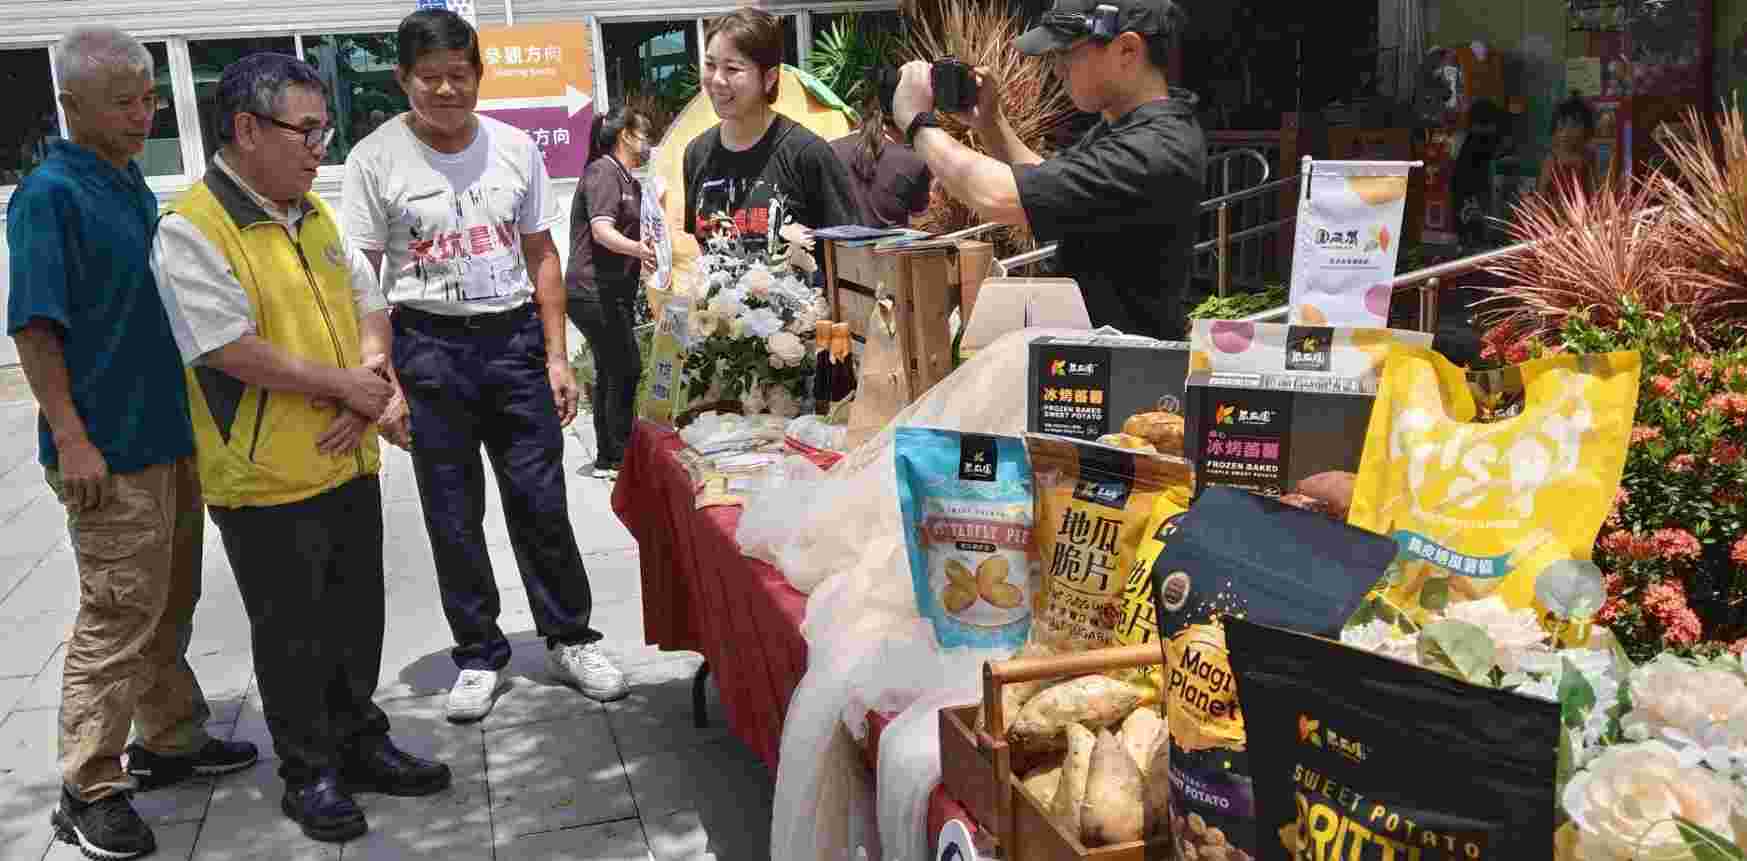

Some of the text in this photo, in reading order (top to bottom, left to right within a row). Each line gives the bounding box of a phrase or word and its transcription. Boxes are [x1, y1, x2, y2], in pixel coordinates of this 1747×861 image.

[527, 127, 570, 145] 方向
[1207, 460, 1279, 473] FROZEN BAKED
[1057, 506, 1124, 557] 地瓜
[1048, 541, 1117, 592] 脆片
[1180, 645, 1233, 693] Magi
[1168, 669, 1238, 721] Planet
[1184, 784, 1231, 810] POTATO
[1293, 763, 1482, 859] SWEET POTATO
